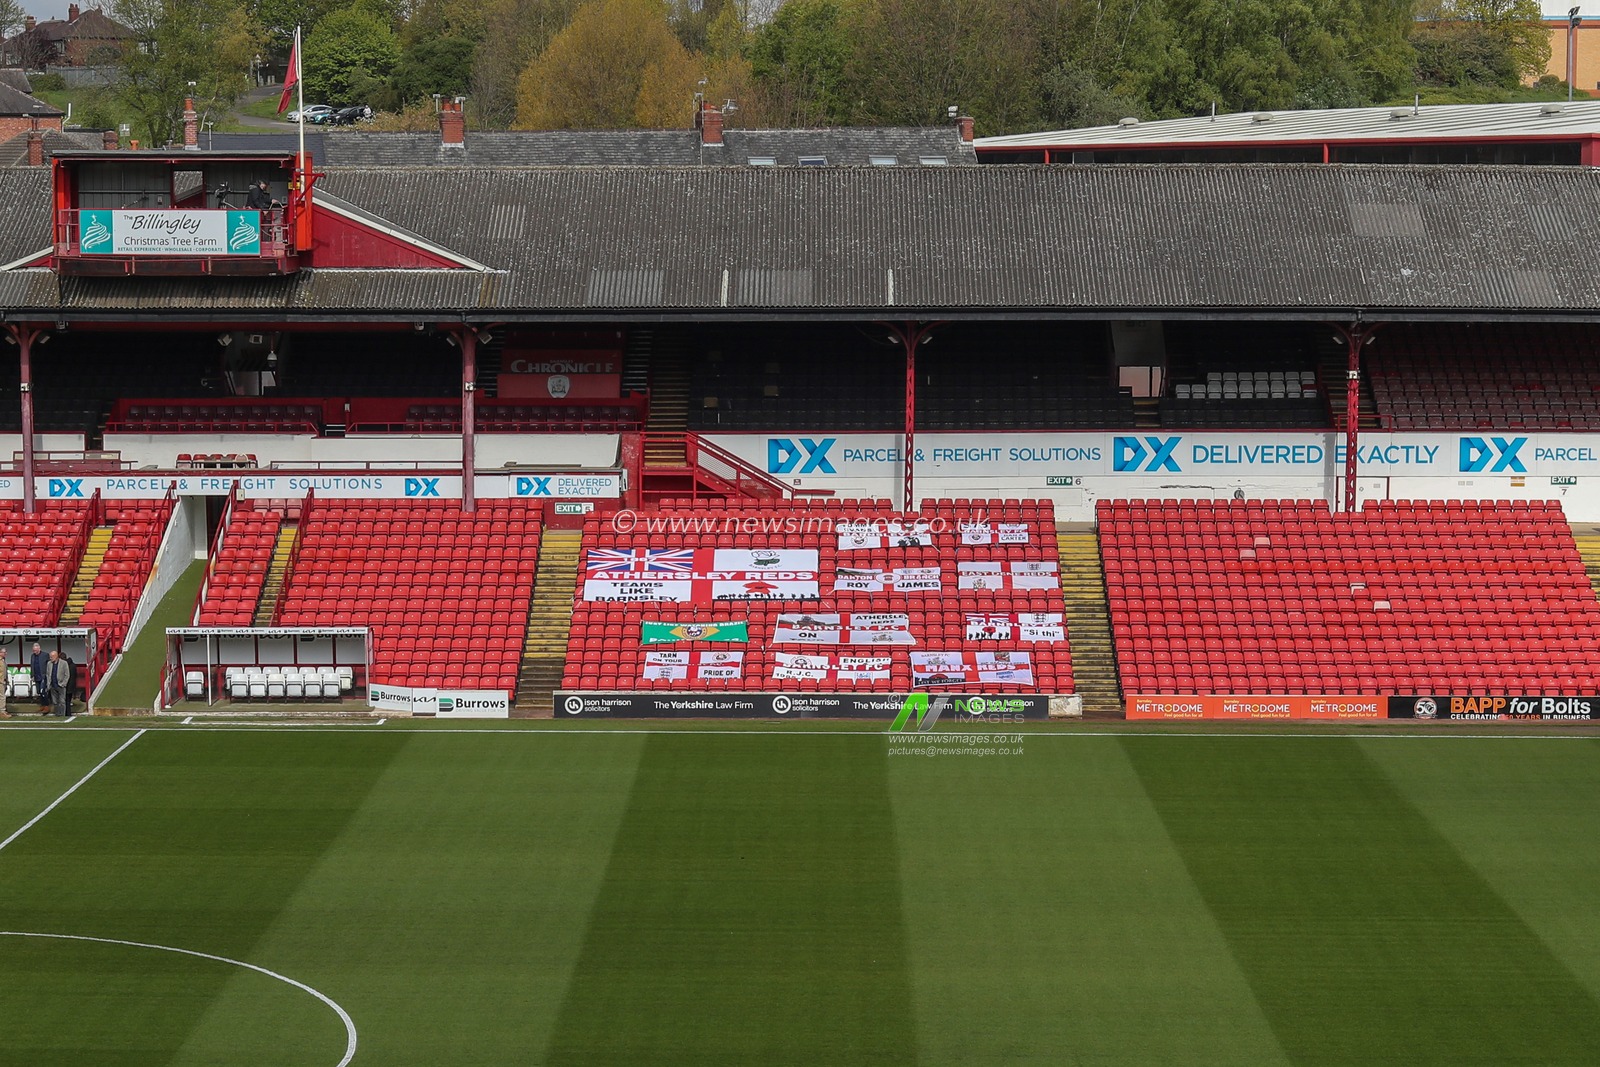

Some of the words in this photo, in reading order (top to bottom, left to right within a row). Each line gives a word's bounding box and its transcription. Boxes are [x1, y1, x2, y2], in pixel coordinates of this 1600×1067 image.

[131, 213, 202, 234] Billingley
[124, 236, 169, 246] Christmas
[171, 236, 191, 246] Tree
[194, 236, 217, 246] Farm
[510, 360, 614, 373] CHRONICLE
[768, 438, 837, 473] DX
[844, 448, 906, 462] PARCEL
[914, 448, 925, 461] &
[934, 448, 1002, 462] FREIGHT
[1009, 448, 1101, 462] SOLUTIONS
[1113, 437, 1182, 472] DX
[1192, 445, 1323, 464] DELIVERED
[1459, 437, 1528, 472] DX
[1535, 448, 1597, 461] PARCEL
[49, 479, 83, 496] DX
[107, 479, 168, 489] PARCEL
[180, 478, 188, 489] &
[201, 479, 275, 489] FREGHT
[289, 479, 383, 490] SOLUTIONS
[405, 478, 440, 496] DX
[516, 477, 552, 495] DX
[592, 571, 736, 580] ATHERSLEY
[745, 572, 814, 580] REDS
[380, 692, 411, 702] Burrows
[456, 698, 505, 708] Burrows
[654, 701, 669, 709] The
[671, 700, 713, 709] Yorkshire
[716, 701, 733, 709] Law
[735, 701, 753, 709] Firm
[870, 701, 912, 710] Yorkshire
[1136, 704, 1203, 712] METRODOME
[1224, 704, 1290, 713] METRODOME
[1311, 704, 1377, 712] METRODOME
[1450, 697, 1506, 714] BAPP
[1509, 698, 1538, 714] for
[1542, 698, 1591, 714] Bolts
